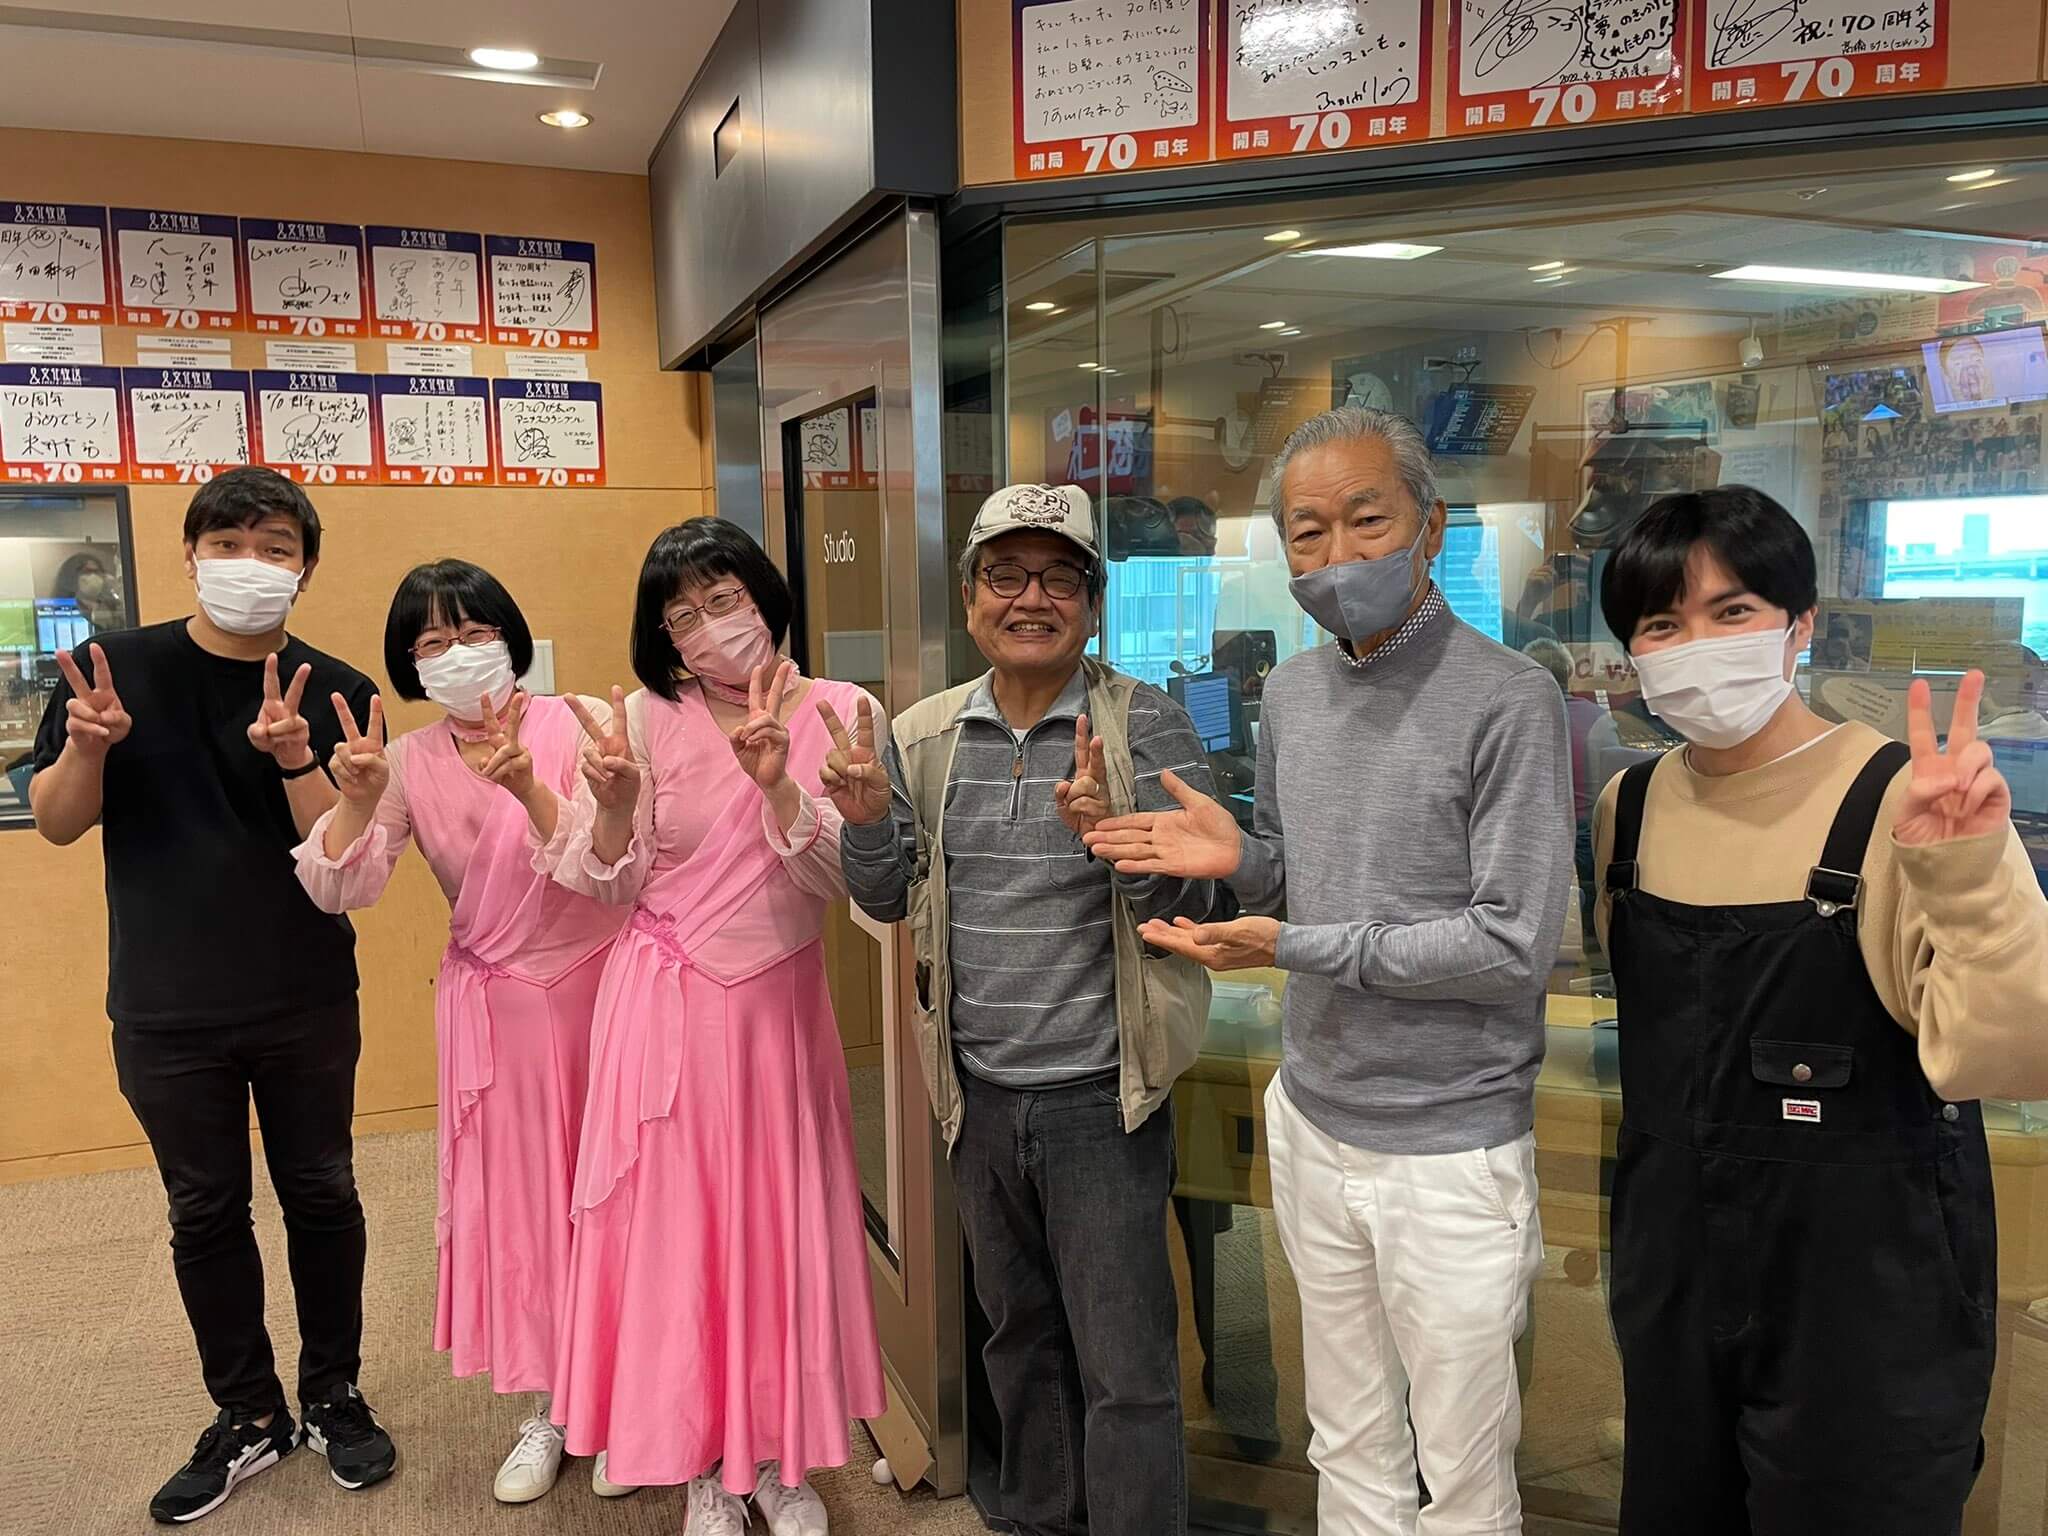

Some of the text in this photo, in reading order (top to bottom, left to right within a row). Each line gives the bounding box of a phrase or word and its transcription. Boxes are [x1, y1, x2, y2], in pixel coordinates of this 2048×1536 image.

[1712, 57, 1921, 102] 開局 70 周年
[1466, 84, 1658, 127] 開局 70 周年
[1233, 112, 1407, 152] 開局 70 周年
[1030, 134, 1189, 173] 開局 70 周年
[28, 302, 67, 323] 70
[162, 309, 200, 329] 70
[289, 316, 326, 336] 70
[412, 322, 446, 341] 70
[528, 329, 561, 348] 70
[43, 463, 82, 483] 70
[175, 464, 213, 483] 70
[301, 465, 337, 484] 70
[421, 466, 455, 484] 70
[536, 469, 568, 486] 70
[824, 530, 856, 563] Studio
